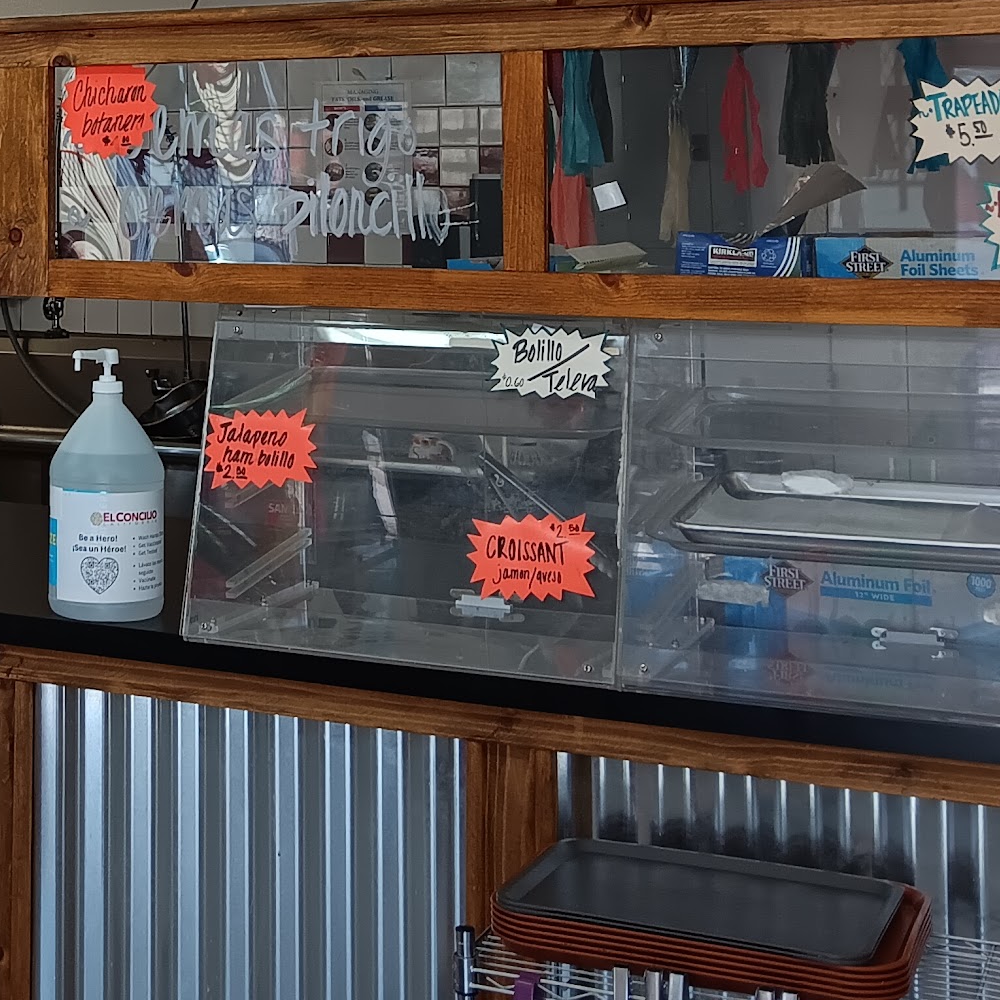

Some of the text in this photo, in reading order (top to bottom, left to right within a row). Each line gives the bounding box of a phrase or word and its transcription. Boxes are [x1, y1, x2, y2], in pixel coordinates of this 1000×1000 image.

[925, 90, 1000, 122] TRAPEAD
[298, 97, 416, 187] trigo
[850, 250, 882, 263] FIRST
[899, 249, 977, 263] Aluminum
[845, 261, 889, 274] STREET
[900, 263, 979, 278] Foil Sheets
[512, 338, 562, 363] Bolillo
[542, 368, 598, 392] Telera
[217, 421, 288, 448] Jalapeno
[222, 446, 295, 469] ham bolillo
[116, 510, 158, 522] CONCILIO
[78, 534, 88, 542] Be
[96, 535, 118, 543] Hero!
[72, 544, 87, 552] ¡Sea
[100, 545, 127, 553] Héroe!
[486, 535, 569, 565] CROISSANT
[769, 564, 801, 578] FIRST
[764, 575, 806, 590] STREET
[821, 570, 931, 595] Aluminum Foil
[871, 593, 895, 602] WIDE
